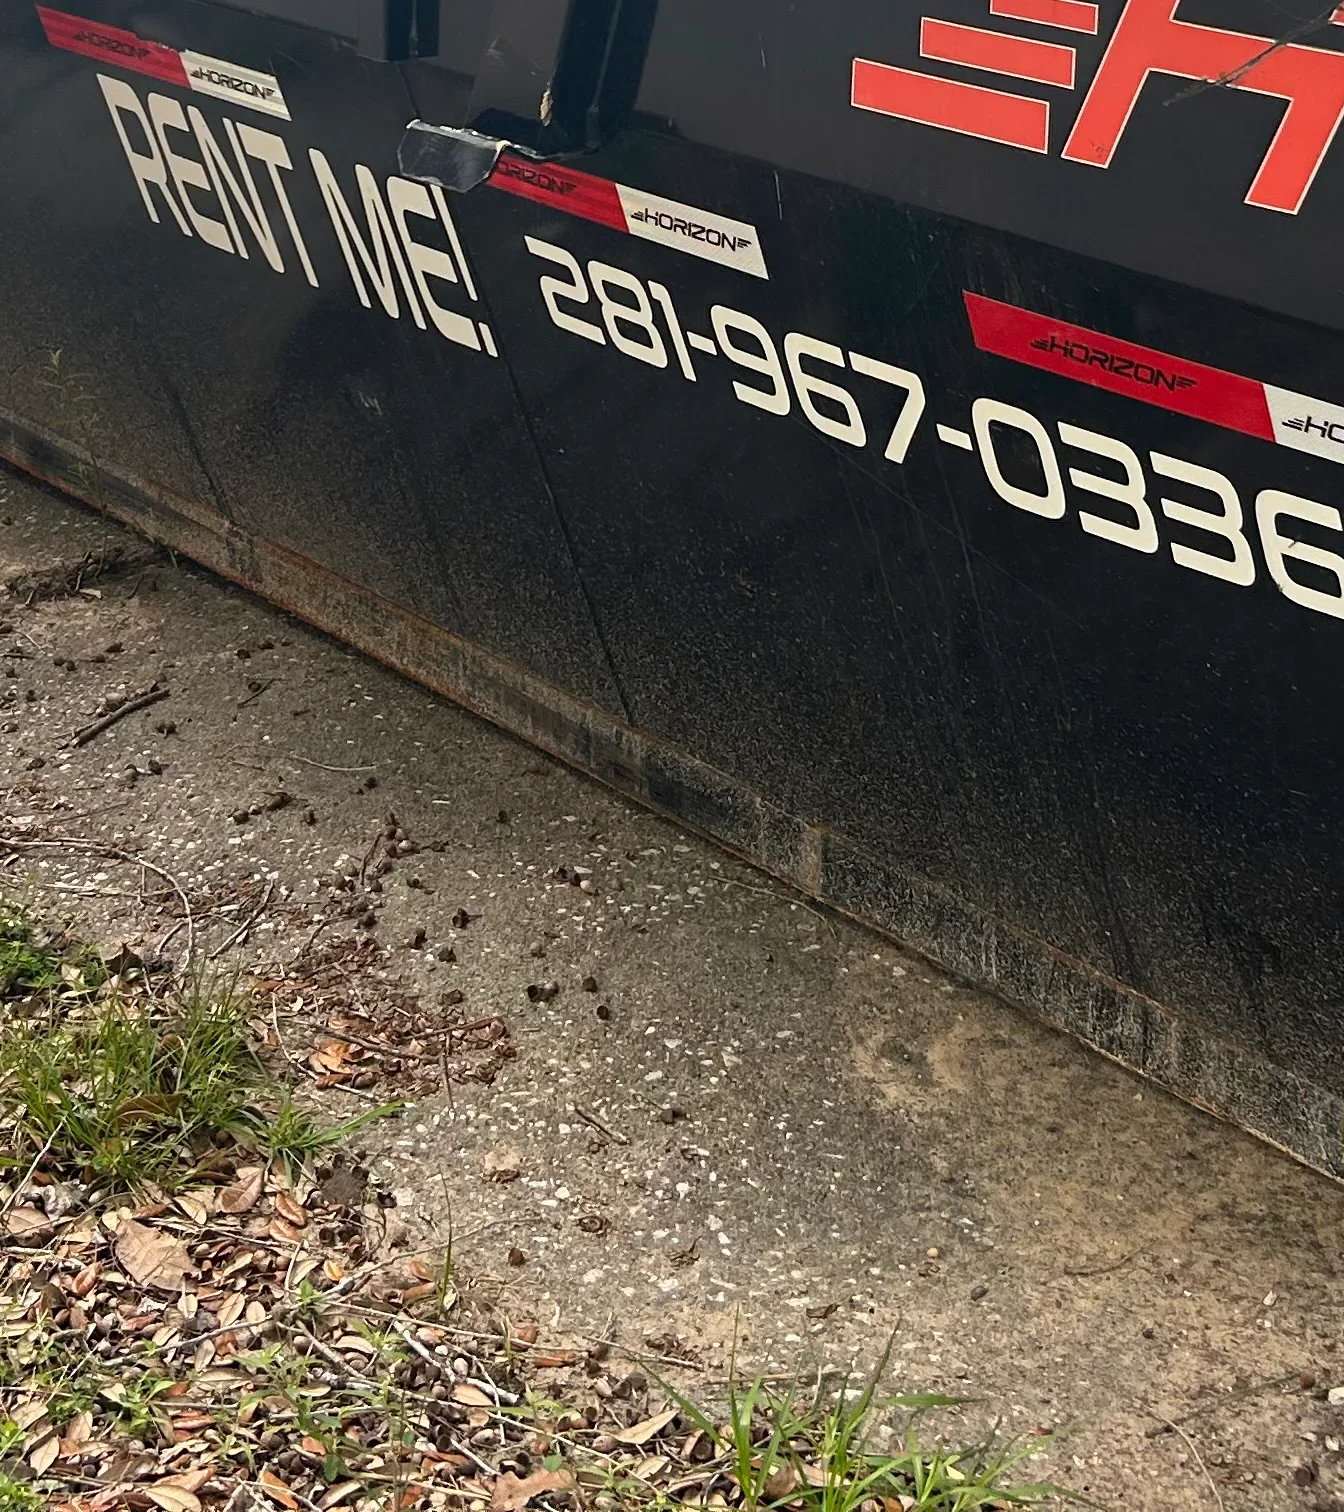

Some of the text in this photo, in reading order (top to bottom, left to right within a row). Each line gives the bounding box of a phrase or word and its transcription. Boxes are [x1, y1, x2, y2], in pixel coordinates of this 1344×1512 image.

[197, 66, 269, 100] HORIZON
[496, 160, 566, 196] ORIZON
[96, 72, 499, 358] RENT ME!
[642, 207, 739, 253] HORIZON
[1046, 335, 1179, 392] HORIZON
